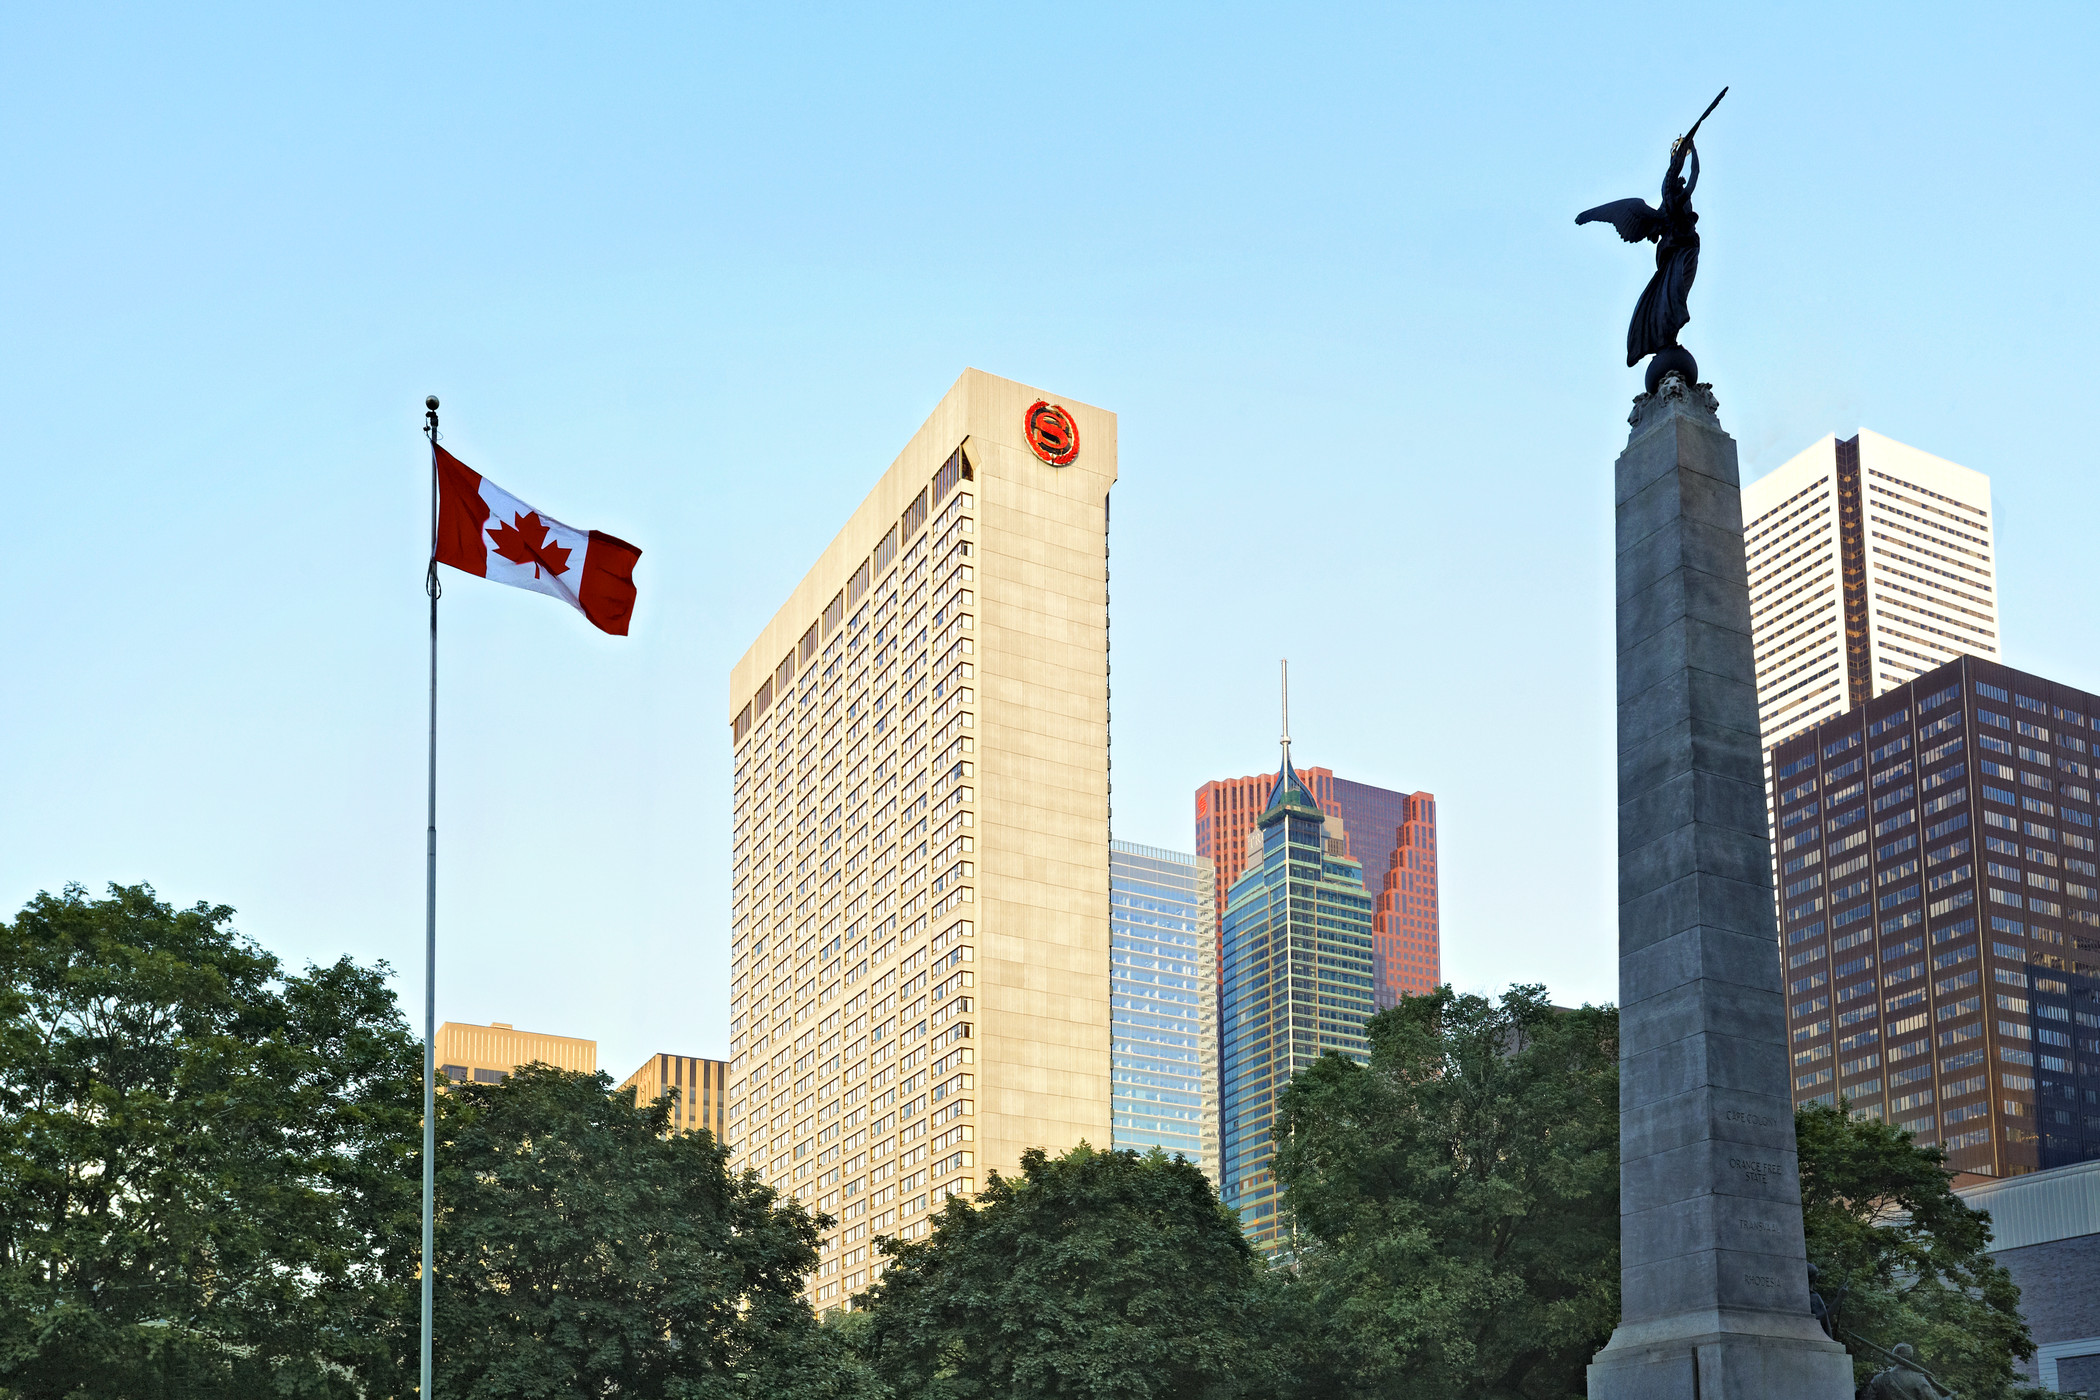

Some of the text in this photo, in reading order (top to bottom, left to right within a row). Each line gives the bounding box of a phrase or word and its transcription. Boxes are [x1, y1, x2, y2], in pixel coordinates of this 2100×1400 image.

[1035, 411, 1069, 449] S
[1726, 1110, 1778, 1127] CAPE COLONY
[1728, 1158, 1782, 1175] ORANGE FREE
[1744, 1171, 1768, 1184] STATE
[1738, 1219, 1780, 1234] TRANSVAAL
[1744, 1274, 1782, 1289] RHODESIA
